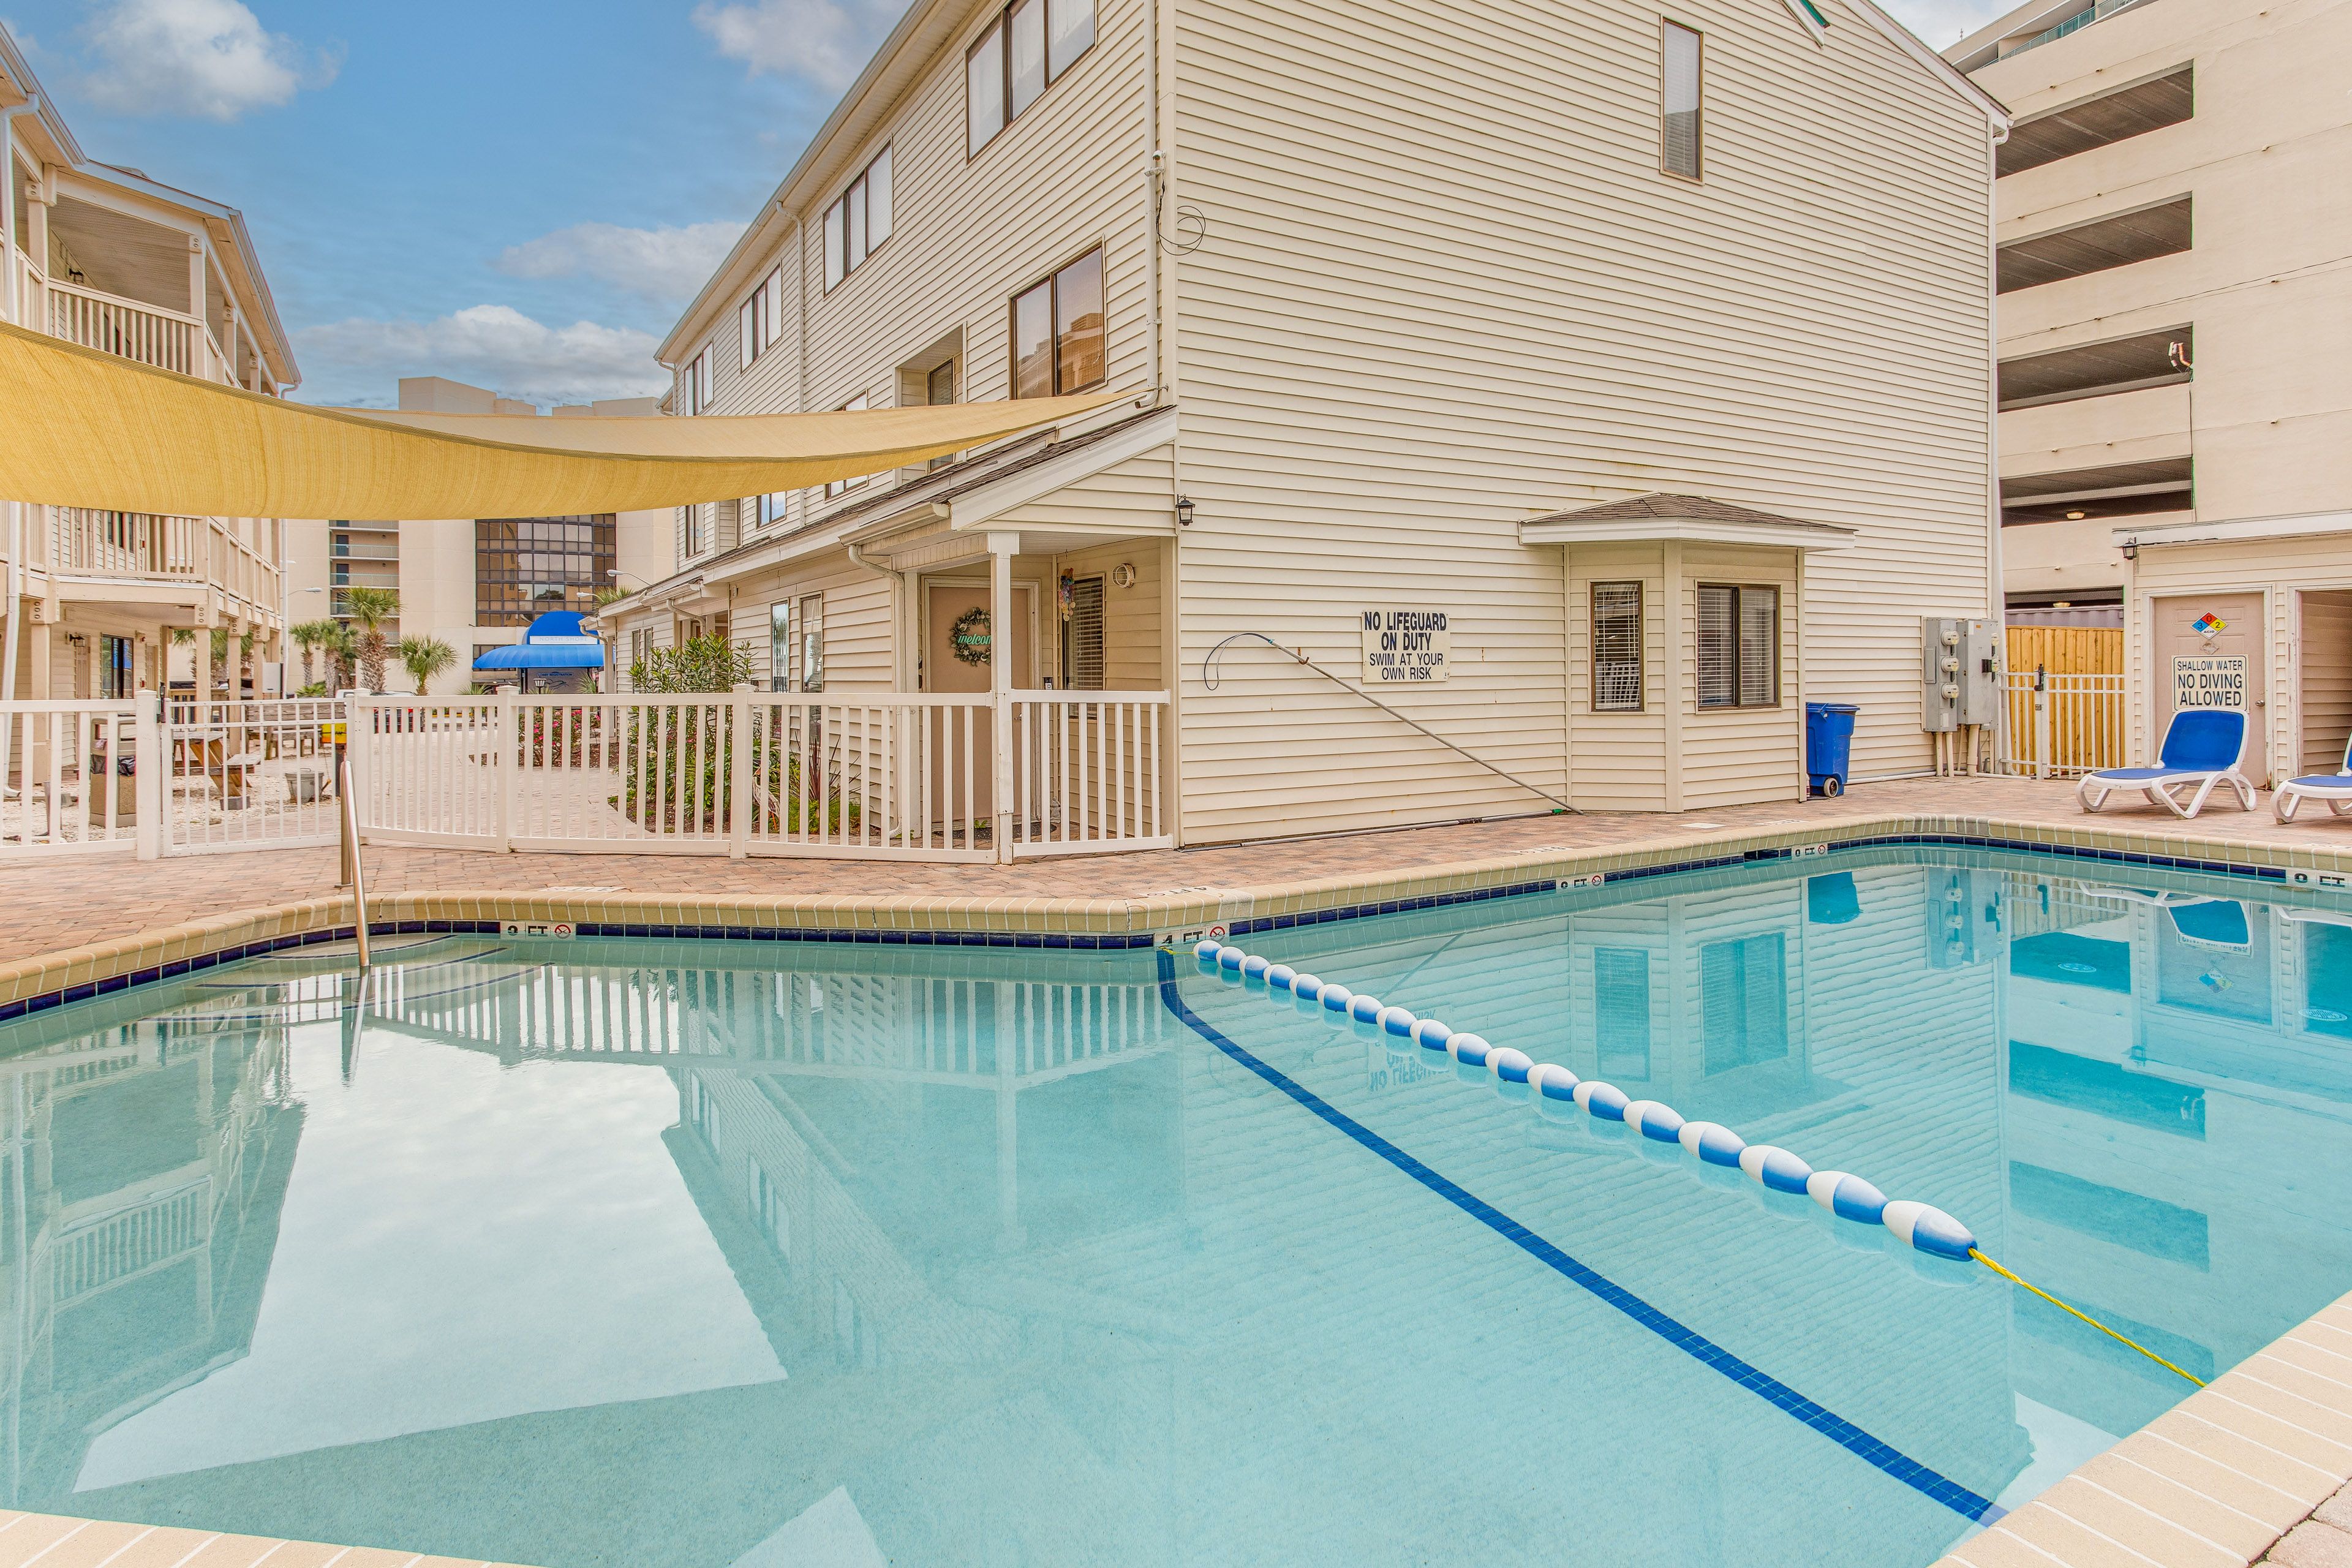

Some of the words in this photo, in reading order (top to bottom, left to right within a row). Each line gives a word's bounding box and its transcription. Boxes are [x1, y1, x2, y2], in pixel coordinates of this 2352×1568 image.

[1365, 611, 1381, 630] NO
[1387, 612, 1447, 631] LIFEGUARD
[1381, 632, 1396, 650] ON
[1403, 633, 1431, 650] DUTY
[1370, 653, 1395, 666] SWIM
[1400, 654, 1412, 665] AT
[1417, 653, 1443, 666] YOUR
[2177, 661, 2213, 671] SHALLOW
[2216, 660, 2242, 670] WATER
[1382, 667, 1404, 680] OWN
[1410, 667, 1431, 680] RISK
[2178, 674, 2195, 688] NO
[2200, 674, 2242, 688] DIVING
[2180, 691, 2241, 706] ALLOWED
